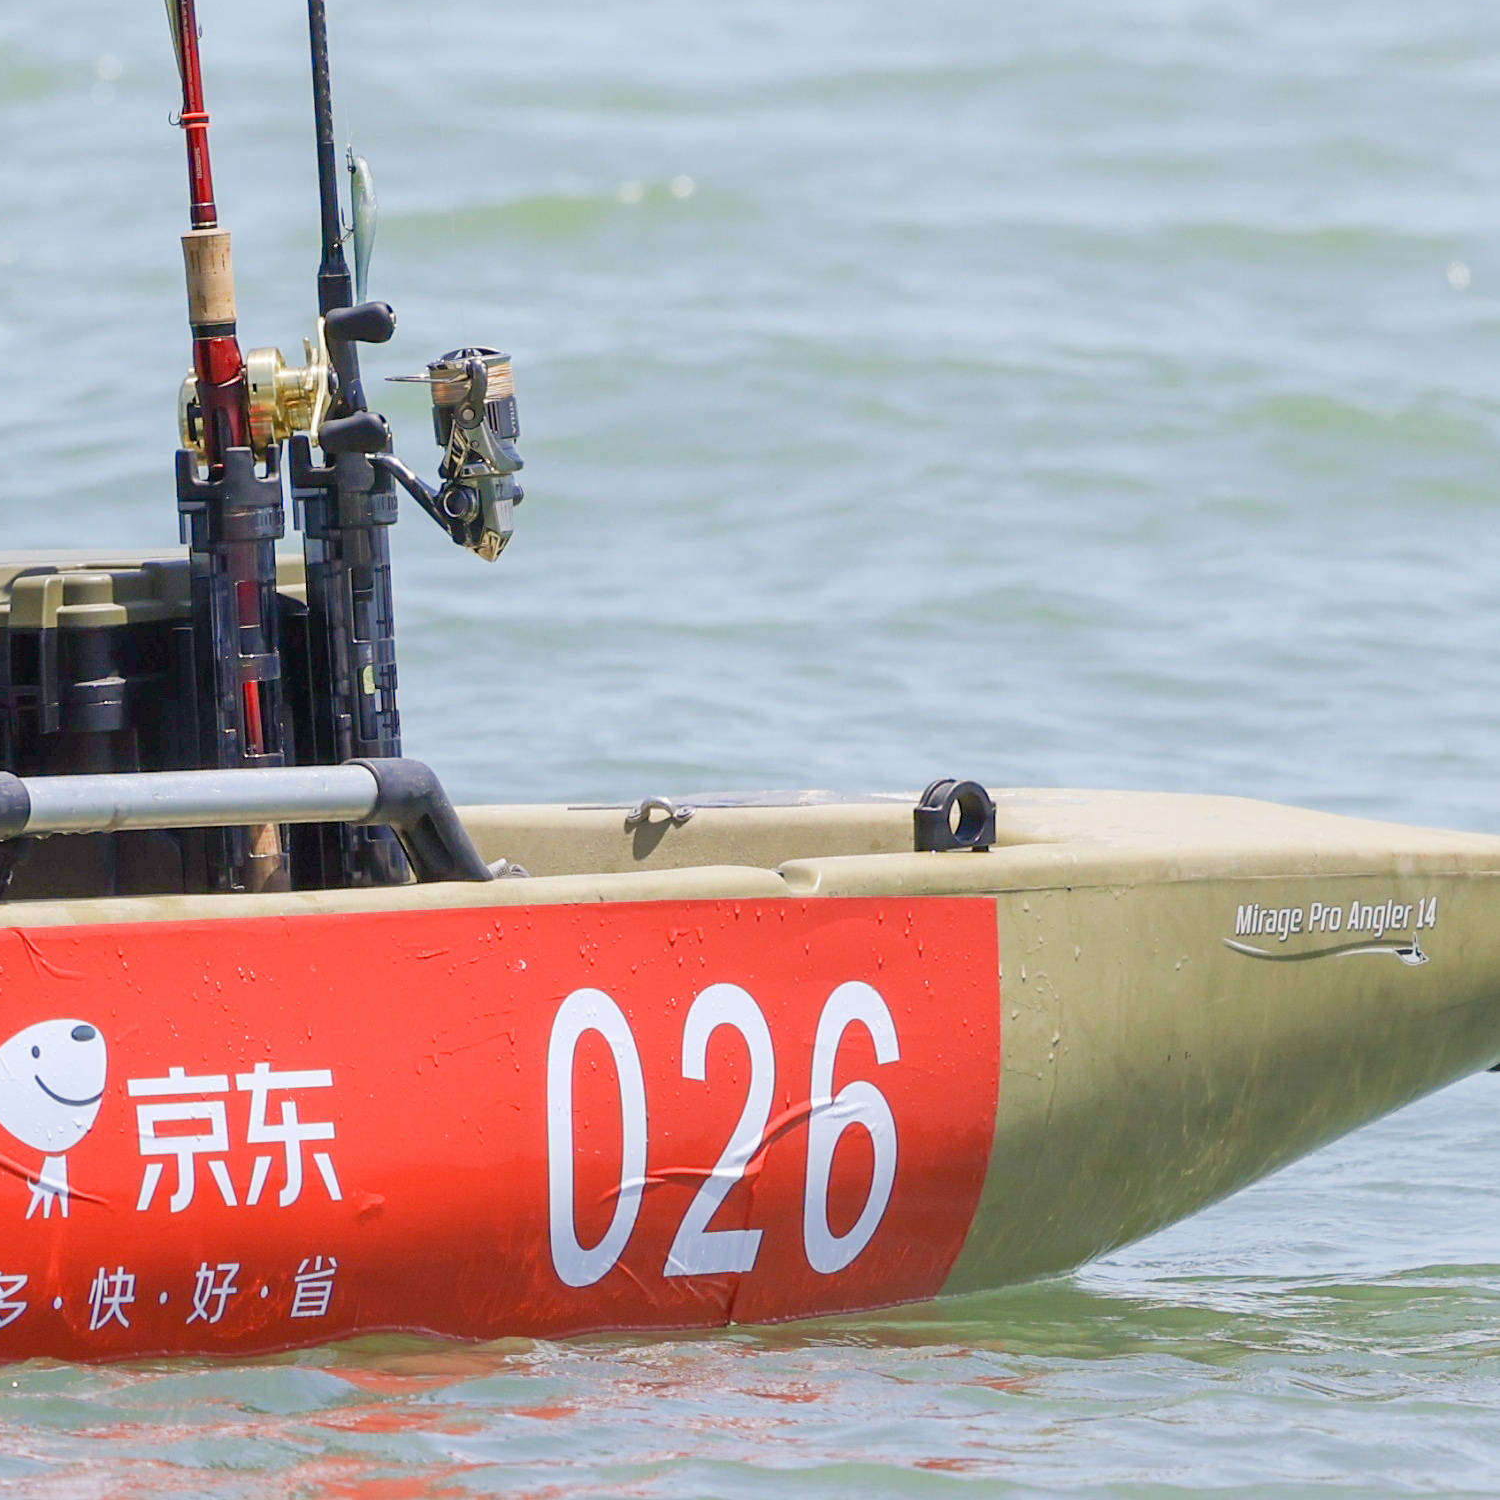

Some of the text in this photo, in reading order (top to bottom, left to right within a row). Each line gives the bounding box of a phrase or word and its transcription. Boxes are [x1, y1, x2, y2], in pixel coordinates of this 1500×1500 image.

[1235, 896, 1438, 941] Mirage Pro Angler 14
[126, 1062, 343, 1213] 京东
[547, 980, 901, 1287] 026
